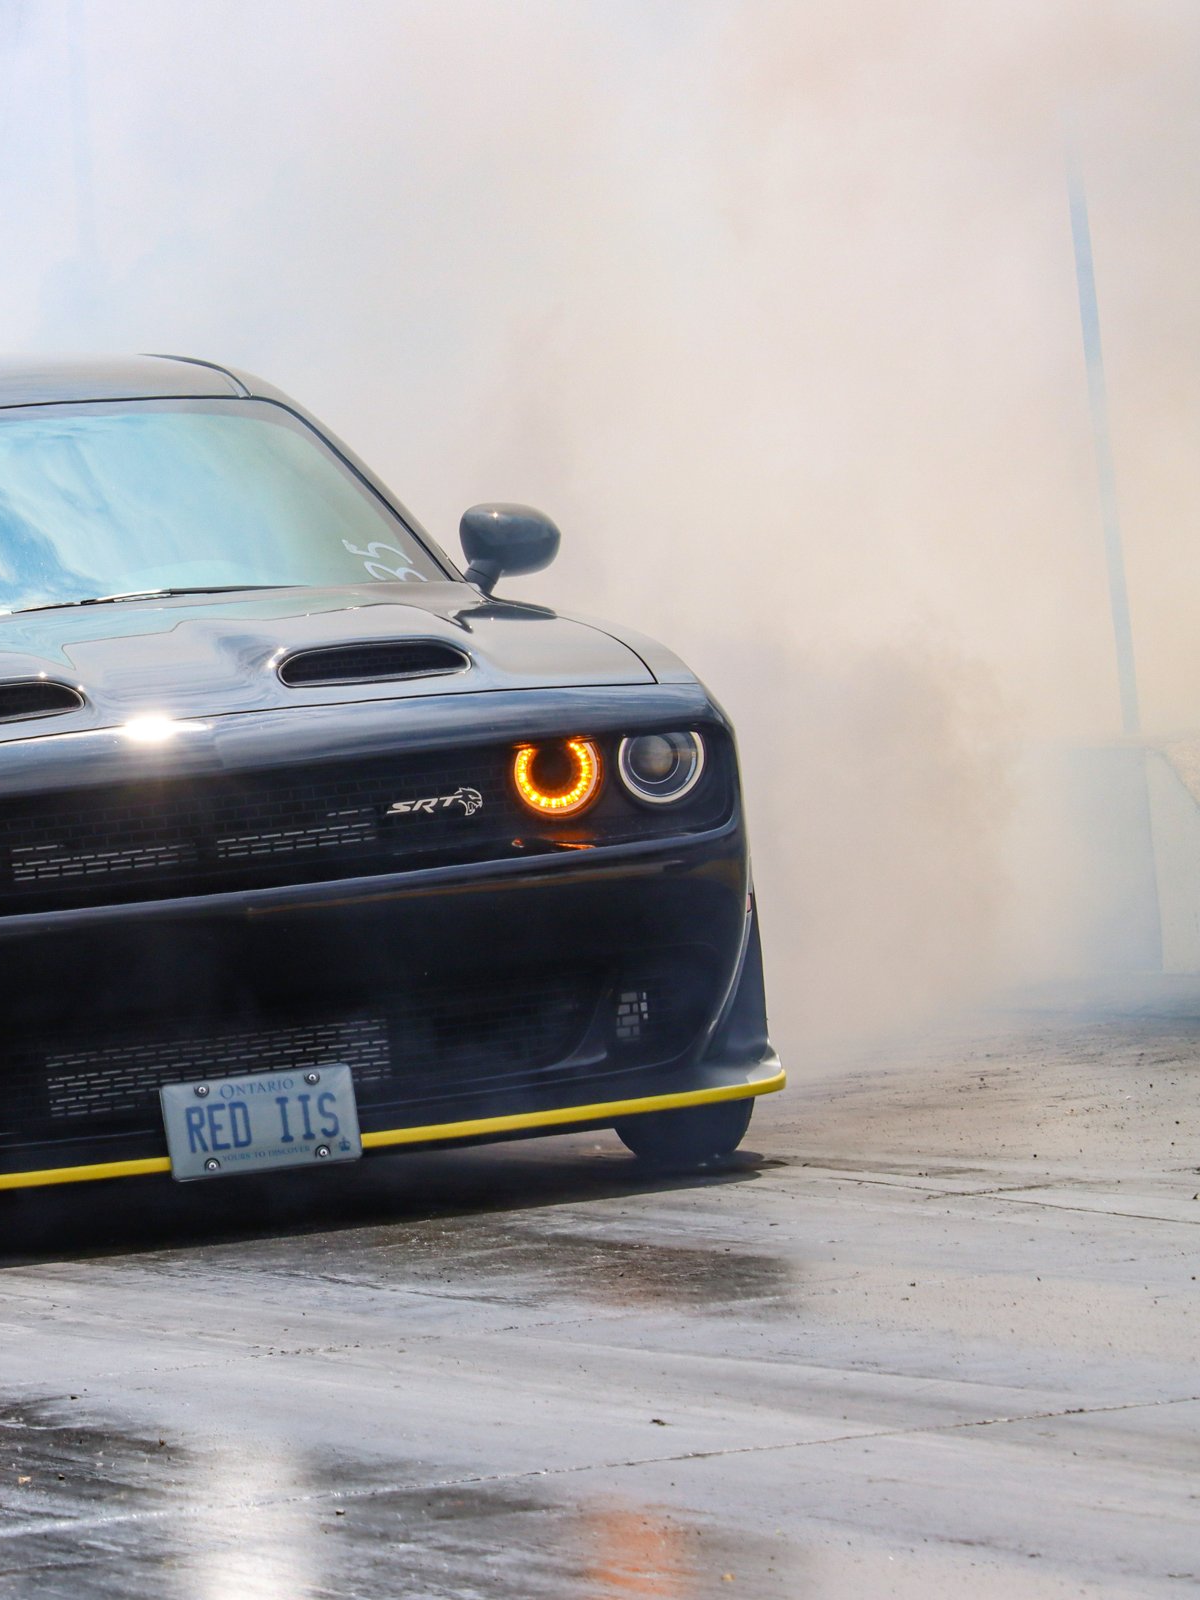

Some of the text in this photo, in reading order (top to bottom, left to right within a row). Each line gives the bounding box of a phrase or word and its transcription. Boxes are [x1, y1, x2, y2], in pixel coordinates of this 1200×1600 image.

[386, 794, 463, 814] SRT
[185, 1101, 253, 1154] RED
[222, 1151, 252, 1162] YOURS
[254, 1150, 266, 1159] TO
